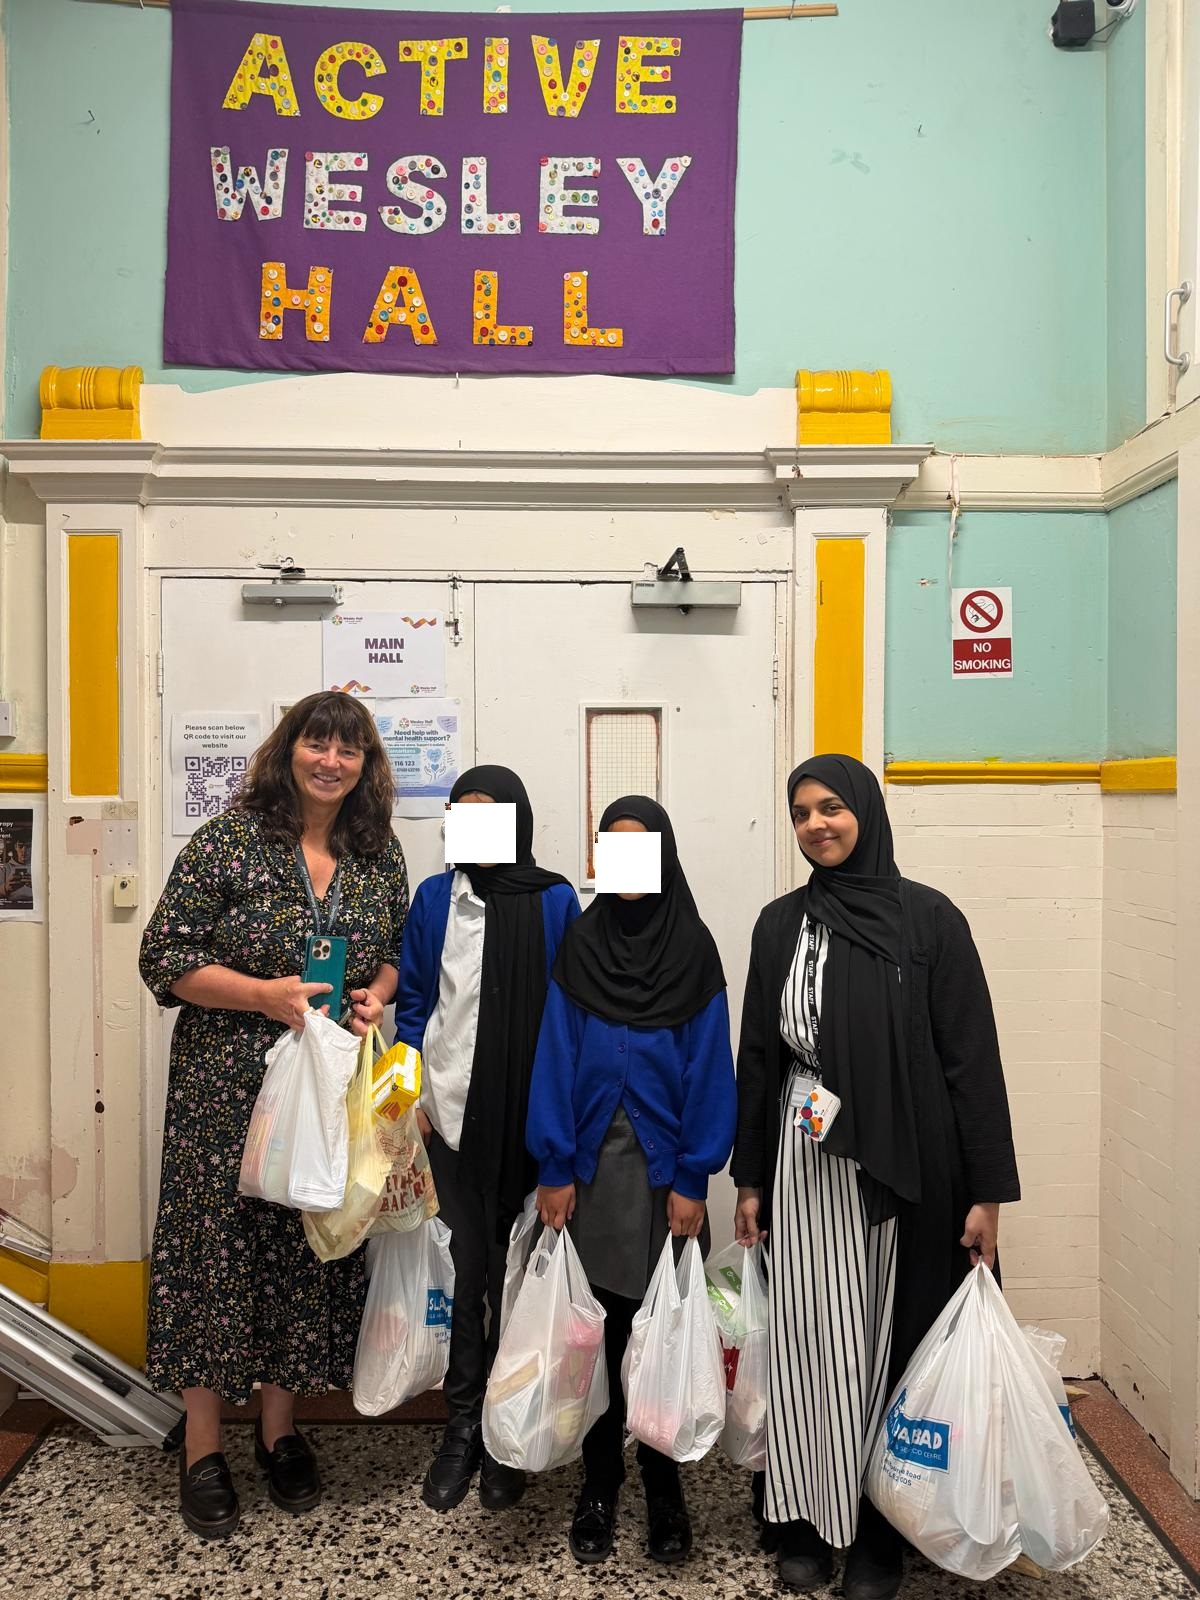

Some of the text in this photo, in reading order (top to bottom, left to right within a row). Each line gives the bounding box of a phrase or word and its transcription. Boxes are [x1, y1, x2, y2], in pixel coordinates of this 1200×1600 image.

[222, 33, 681, 119] ACTIVE
[210, 146, 692, 236] WESLEY
[259, 261, 624, 347] HALL
[365, 638, 404, 649] MAIN
[973, 642, 992, 653] NO
[369, 653, 403, 663] HALL
[954, 659, 1011, 670] SMOKING
